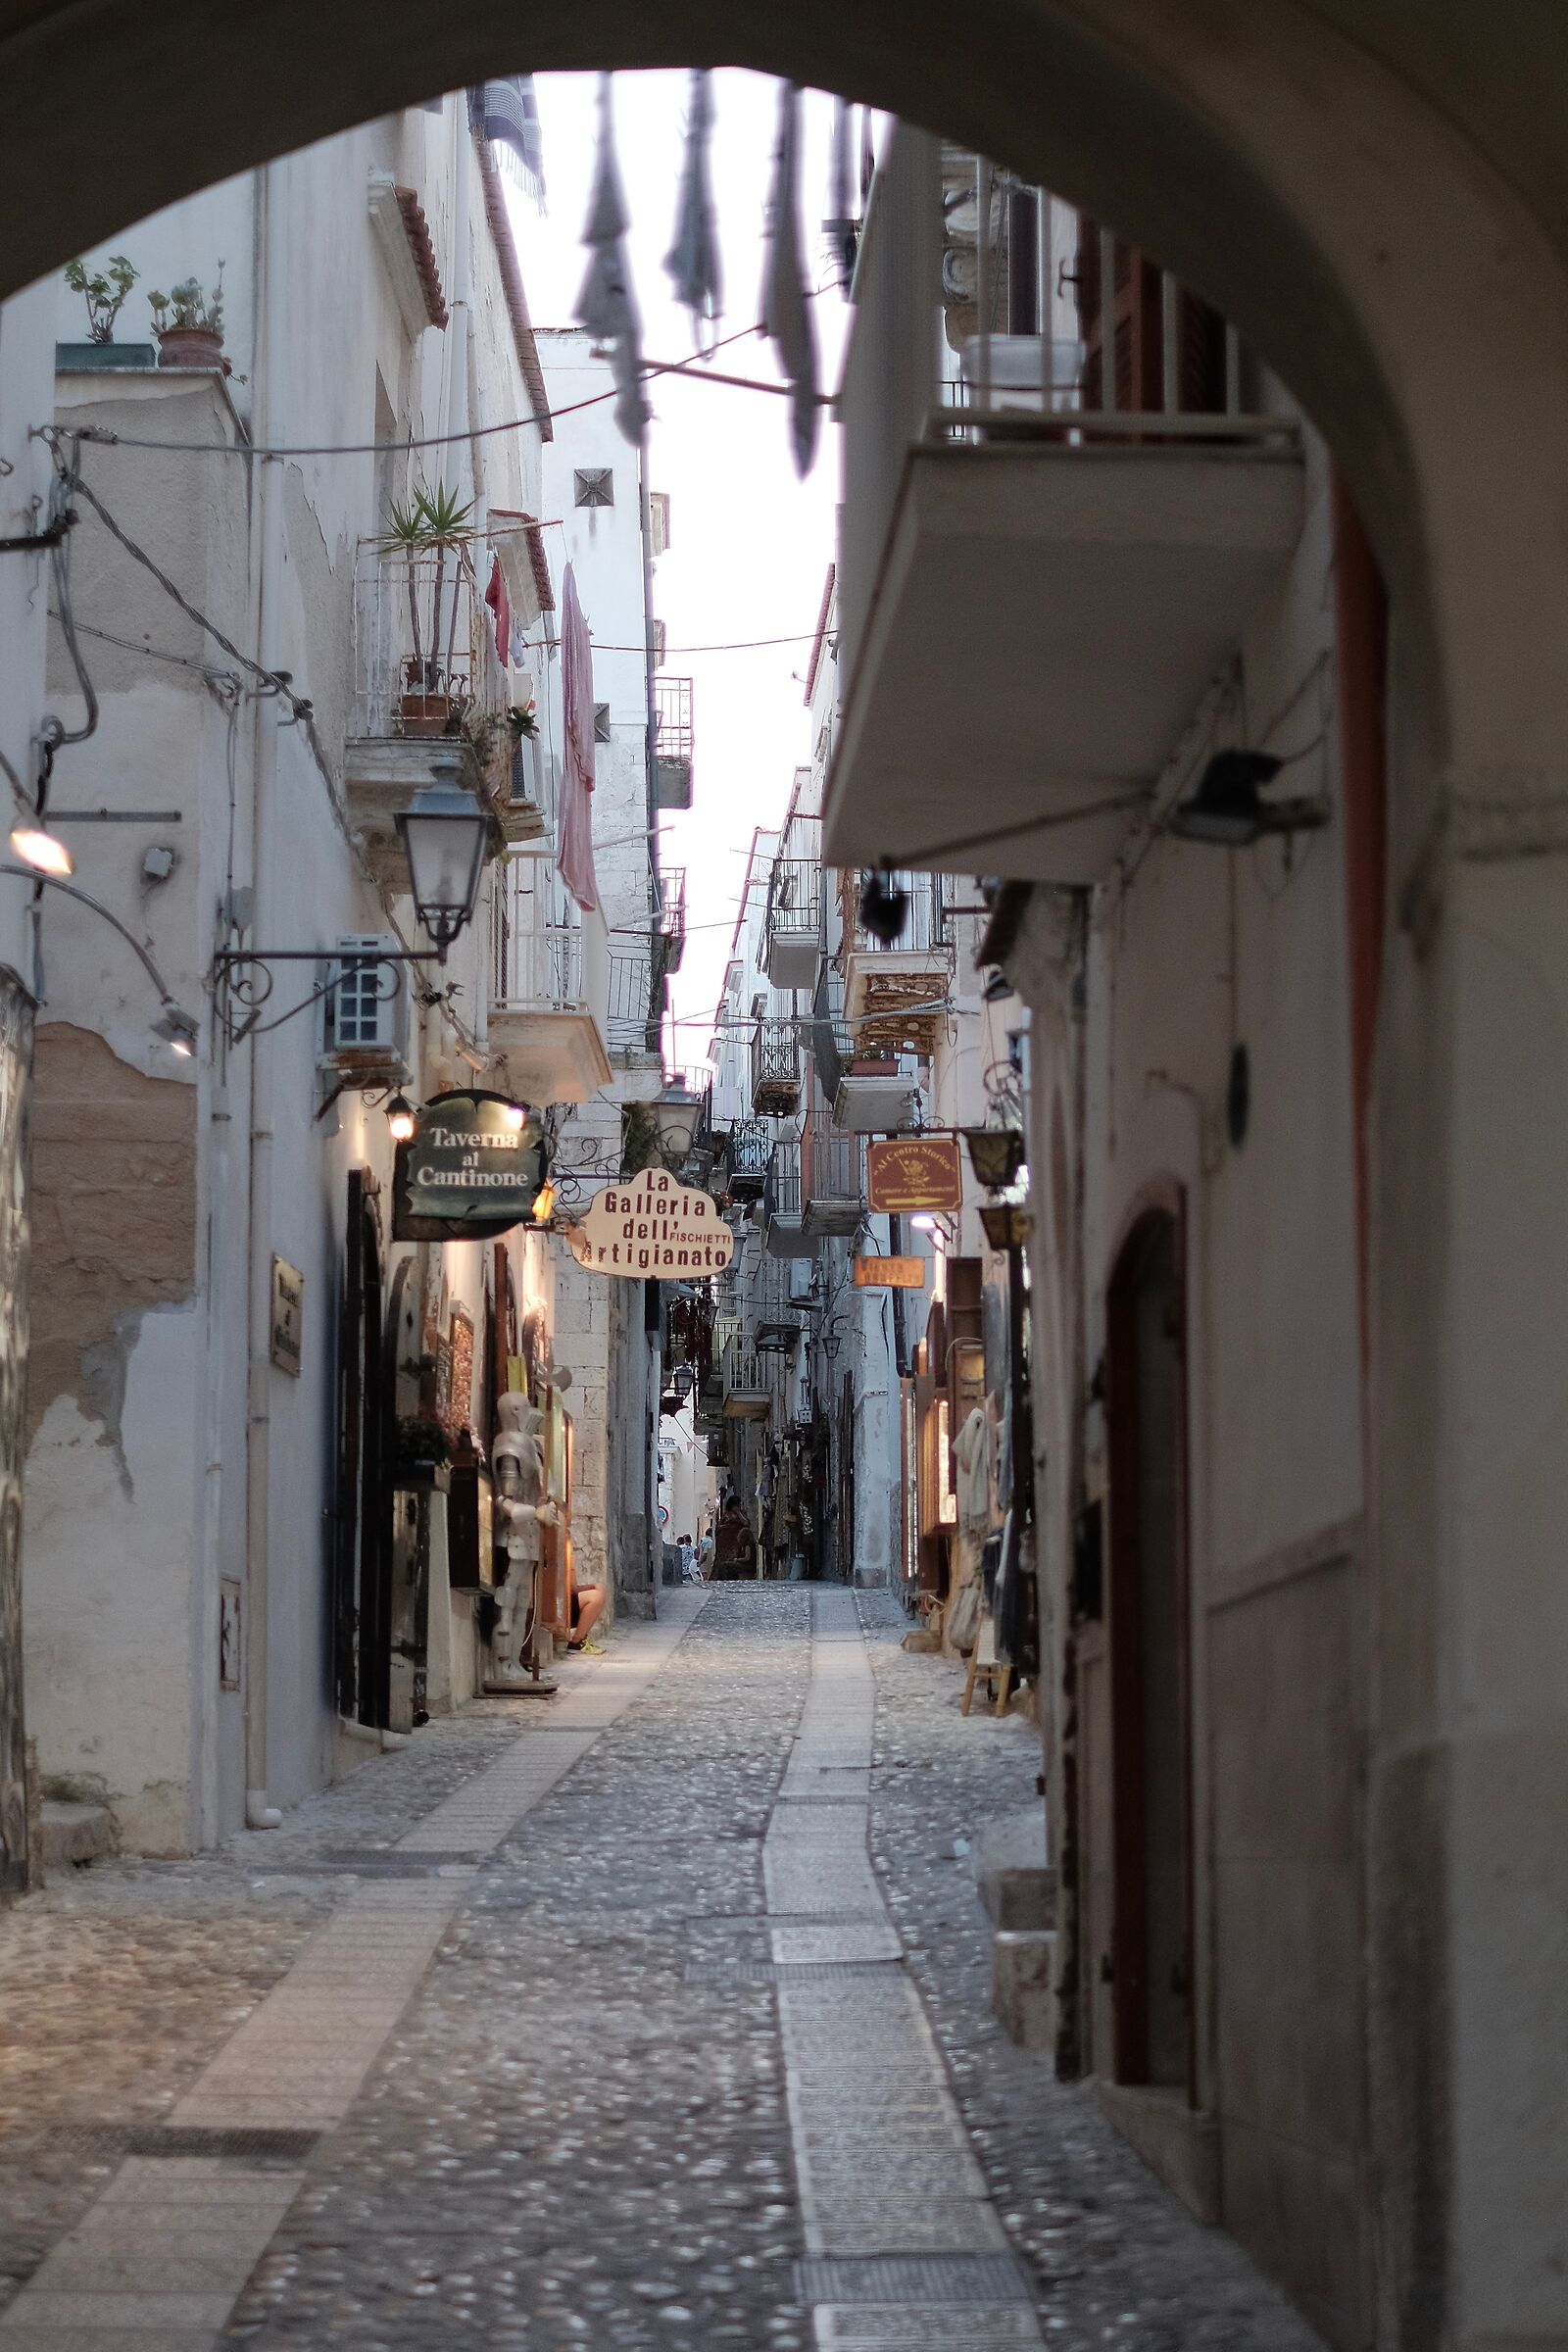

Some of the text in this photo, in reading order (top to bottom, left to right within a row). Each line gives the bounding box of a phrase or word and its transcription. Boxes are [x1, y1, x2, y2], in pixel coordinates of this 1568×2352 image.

[430, 1128, 518, 1149] Taverna
[462, 1152, 479, 1166] al
[886, 1146, 919, 1161] Centro
[416, 1166, 529, 1187] Cantinone
[646, 1170, 668, 1192] La
[605, 1191, 706, 1216] Galleria
[622, 1218, 679, 1241] dell'
[669, 1232, 731, 1245] FISCHIETTI
[580, 1241, 727, 1269] Artigianato
